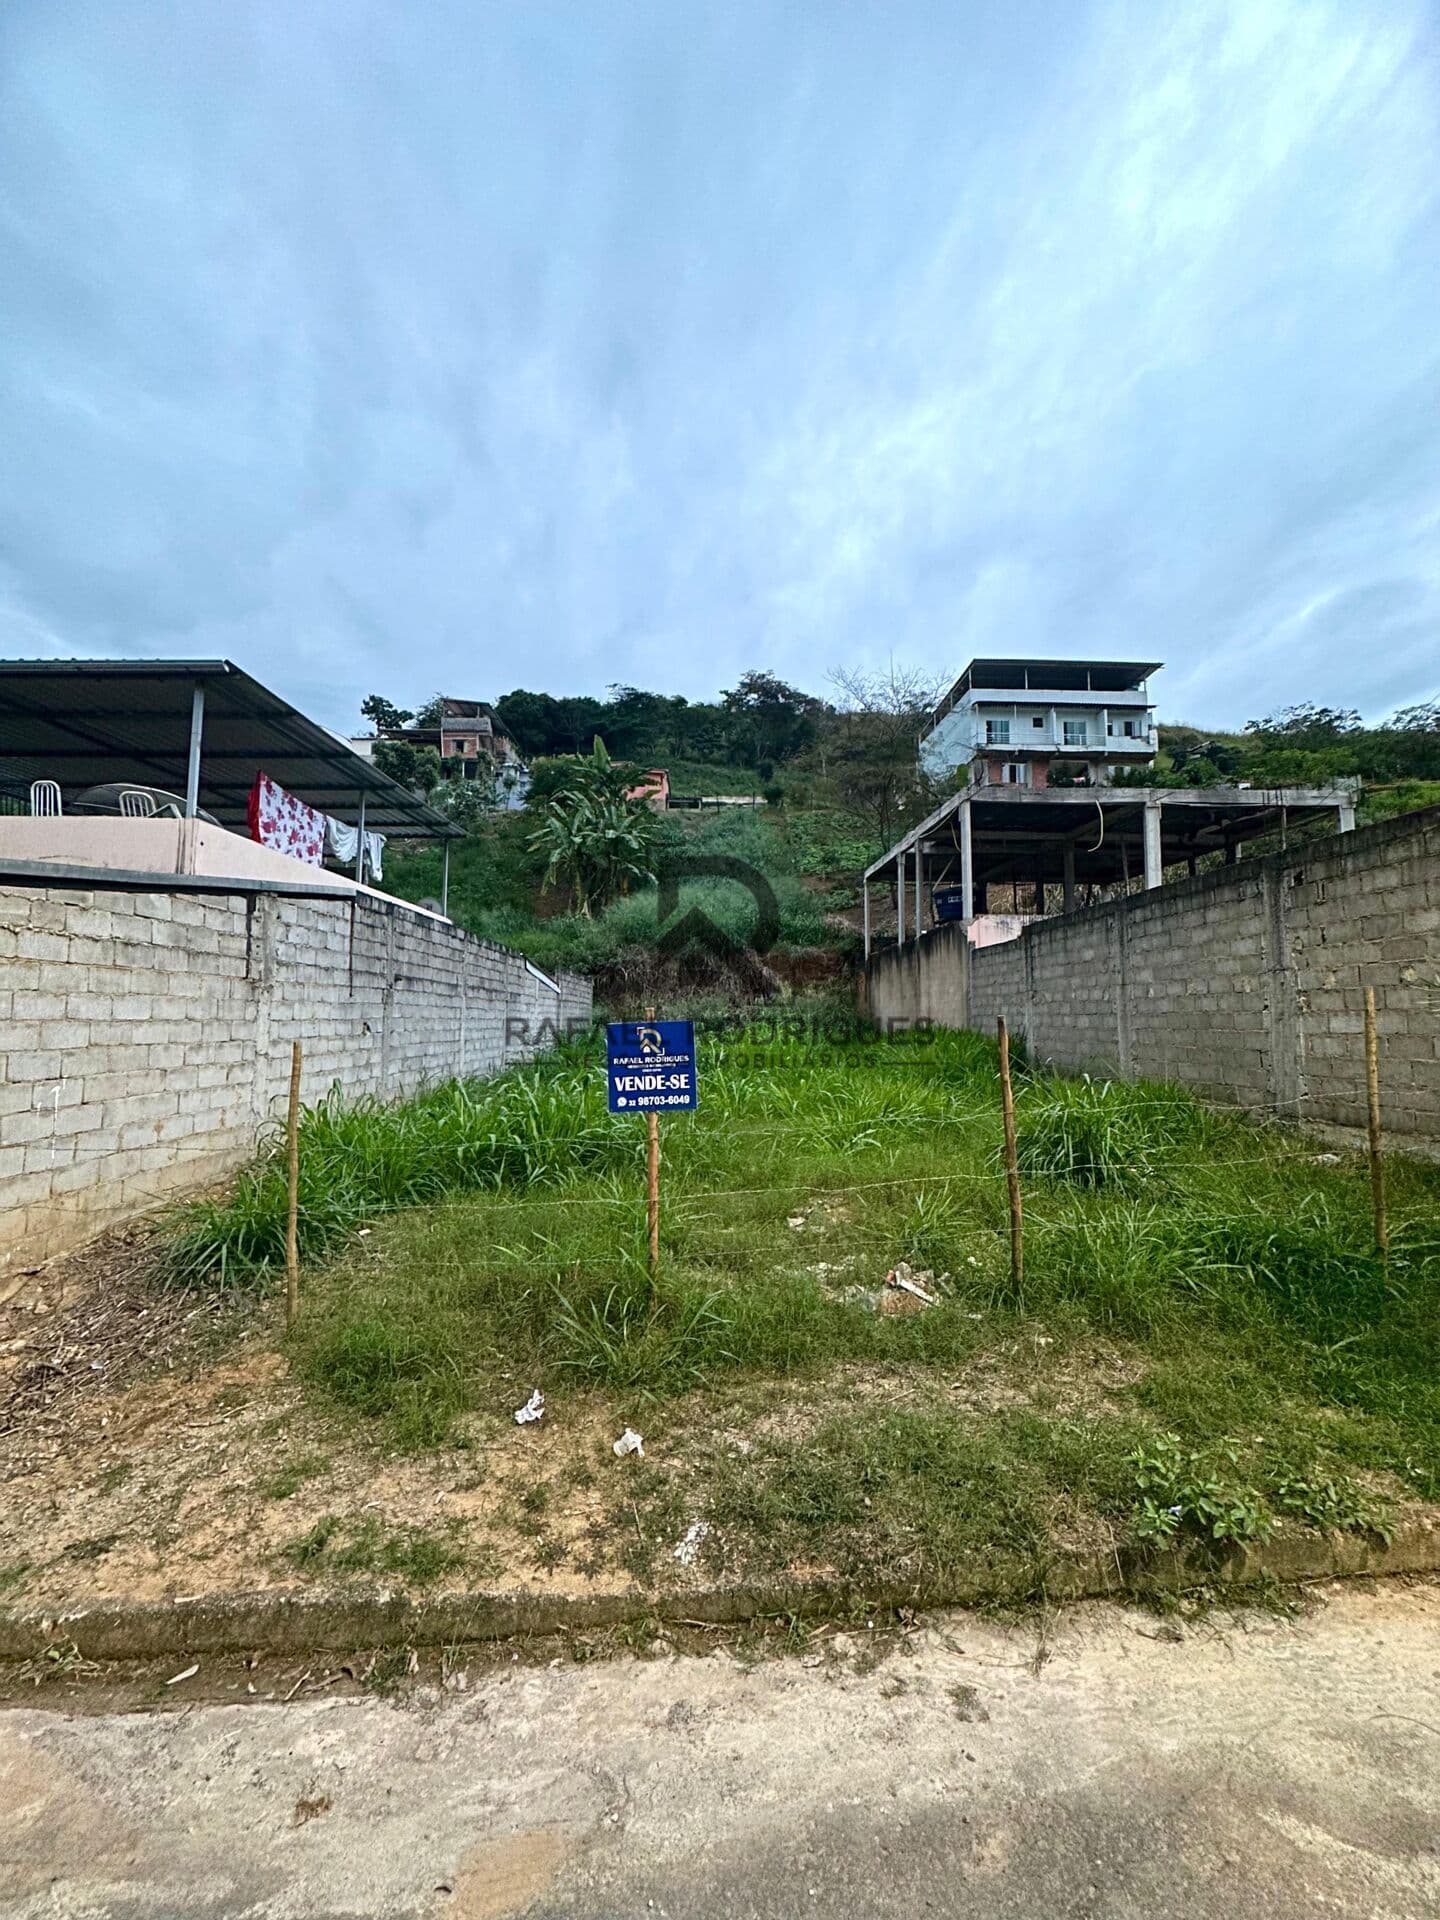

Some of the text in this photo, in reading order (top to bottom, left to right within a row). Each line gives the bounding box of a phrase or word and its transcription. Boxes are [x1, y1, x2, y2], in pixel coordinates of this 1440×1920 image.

[613, 1057, 643, 1065] RAFAEL
[645, 1055, 690, 1064] RODRIGUES
[615, 1074, 690, 1091] VENDE-SE
[638, 1095, 690, 1106] 98703-6049
